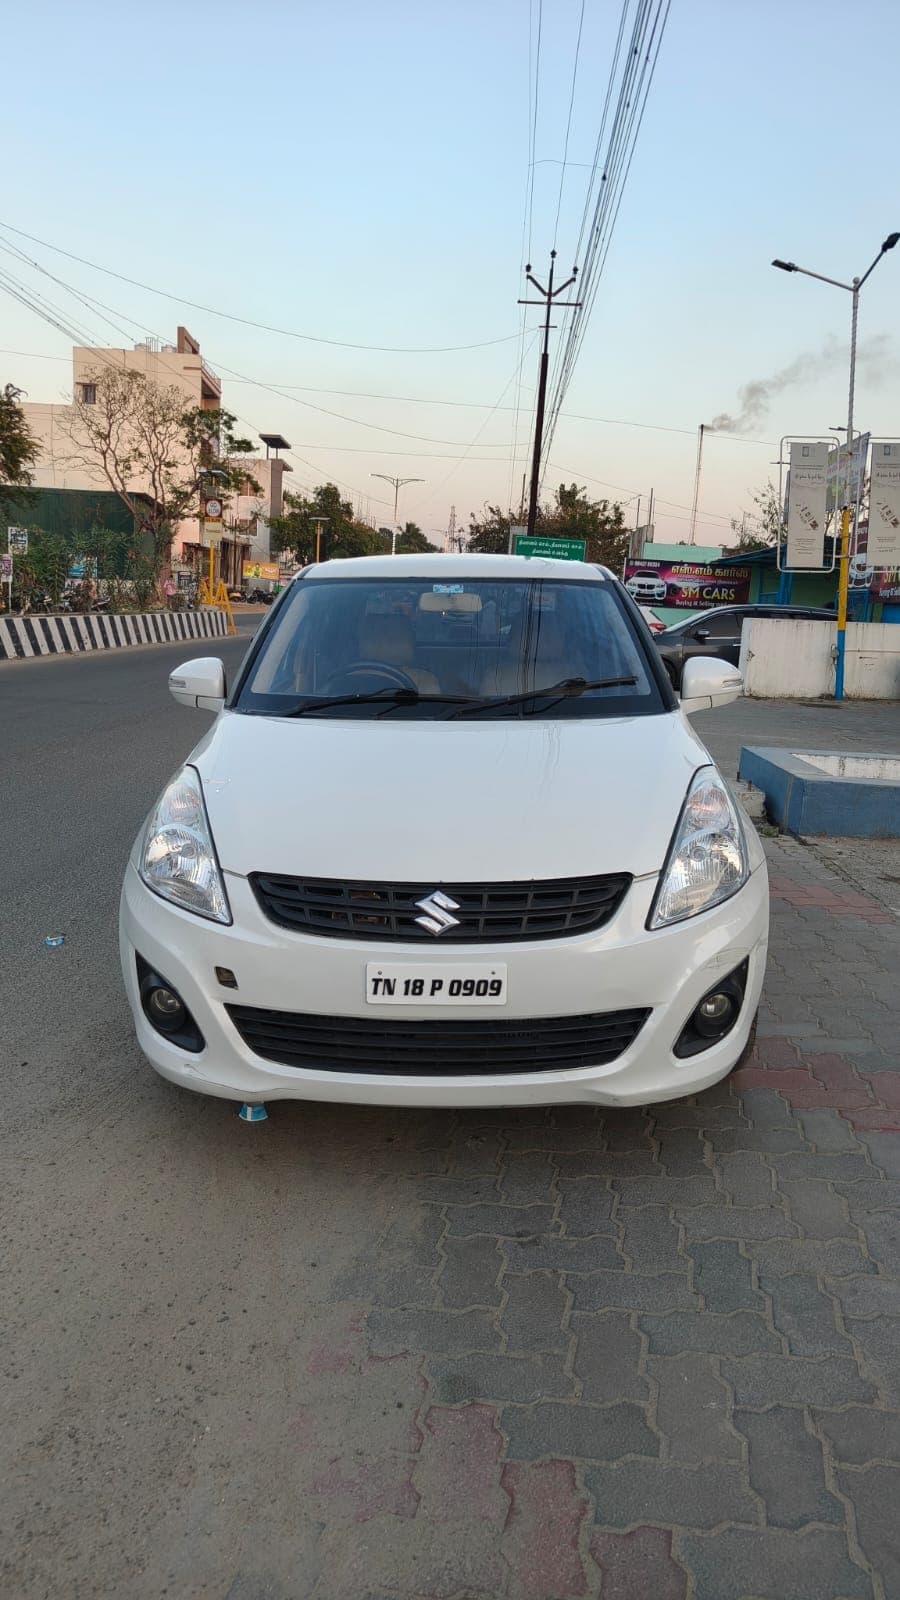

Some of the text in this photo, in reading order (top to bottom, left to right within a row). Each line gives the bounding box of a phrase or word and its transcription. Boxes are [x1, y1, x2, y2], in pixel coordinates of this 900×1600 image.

[681, 586, 735, 600] SM CARS
[372, 978, 503, 998] TN 18 P 0909
